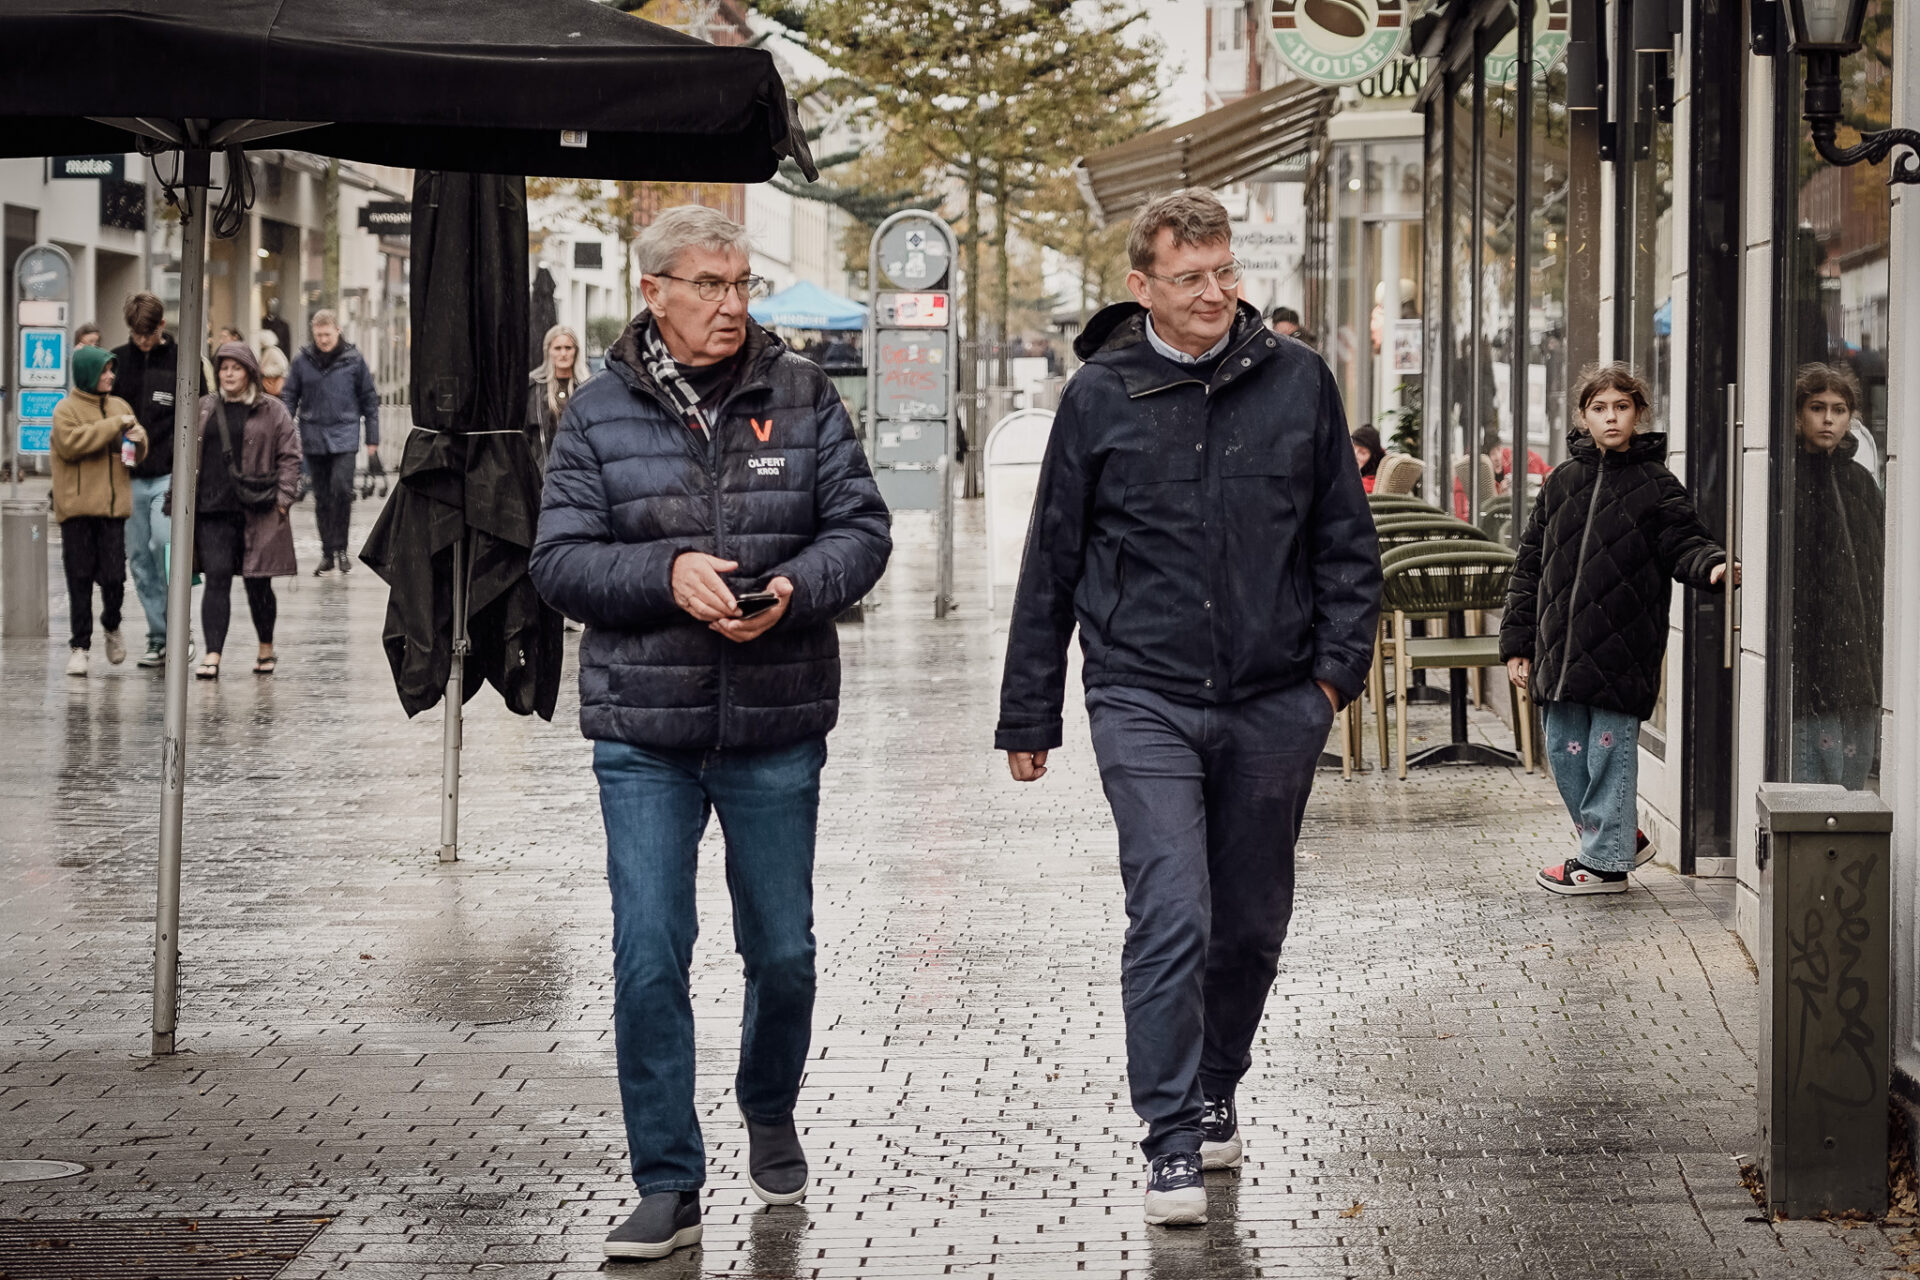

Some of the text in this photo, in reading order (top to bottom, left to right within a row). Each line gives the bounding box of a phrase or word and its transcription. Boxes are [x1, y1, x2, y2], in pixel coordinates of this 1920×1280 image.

[1289, 42, 1385, 77] HOUSE
[65, 159, 113, 174] matas
[750, 417, 773, 442] V
[747, 457, 786, 469] OLFERT
[756, 467, 780, 476] KROG
